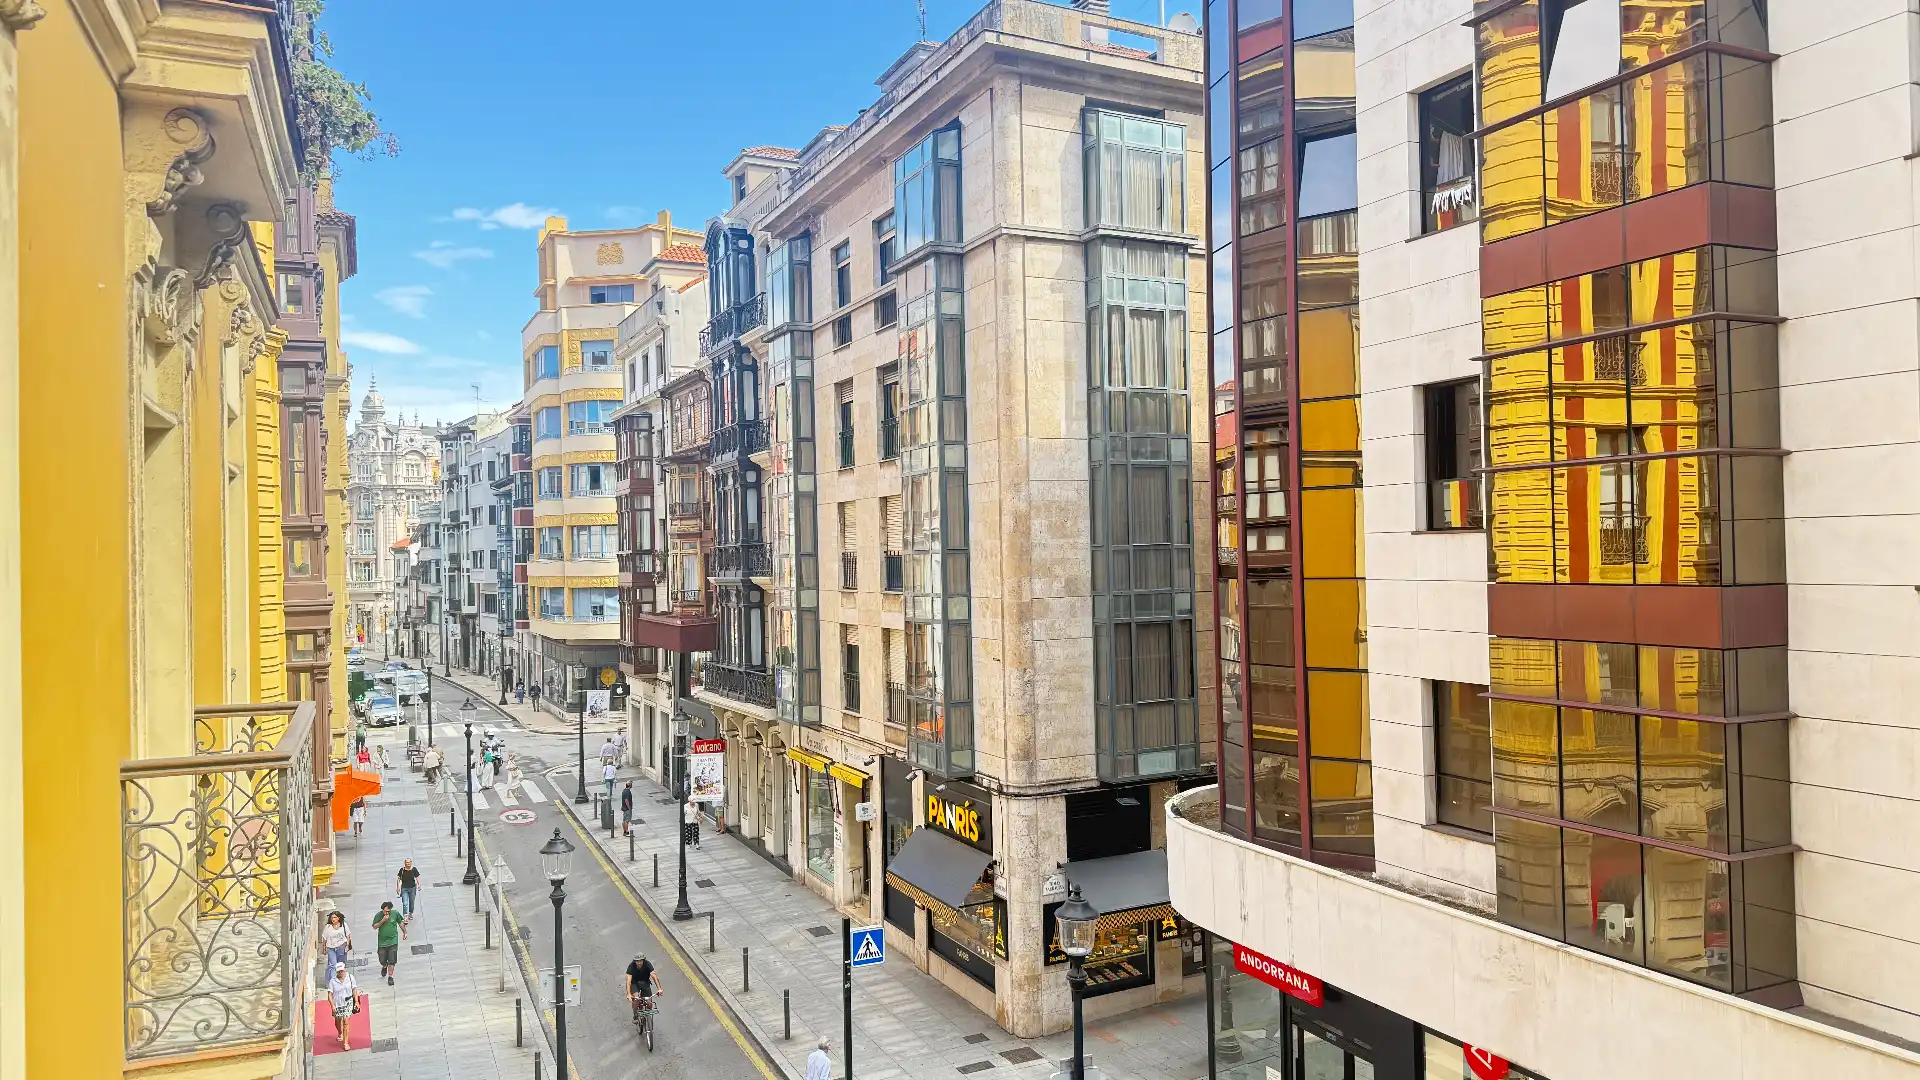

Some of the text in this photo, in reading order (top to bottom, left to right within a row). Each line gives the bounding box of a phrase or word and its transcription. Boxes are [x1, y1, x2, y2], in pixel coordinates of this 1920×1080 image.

[696, 742, 722, 752] volcano
[928, 795, 979, 842] PANRÍS
[1240, 950, 1311, 993] ANDORRANA
